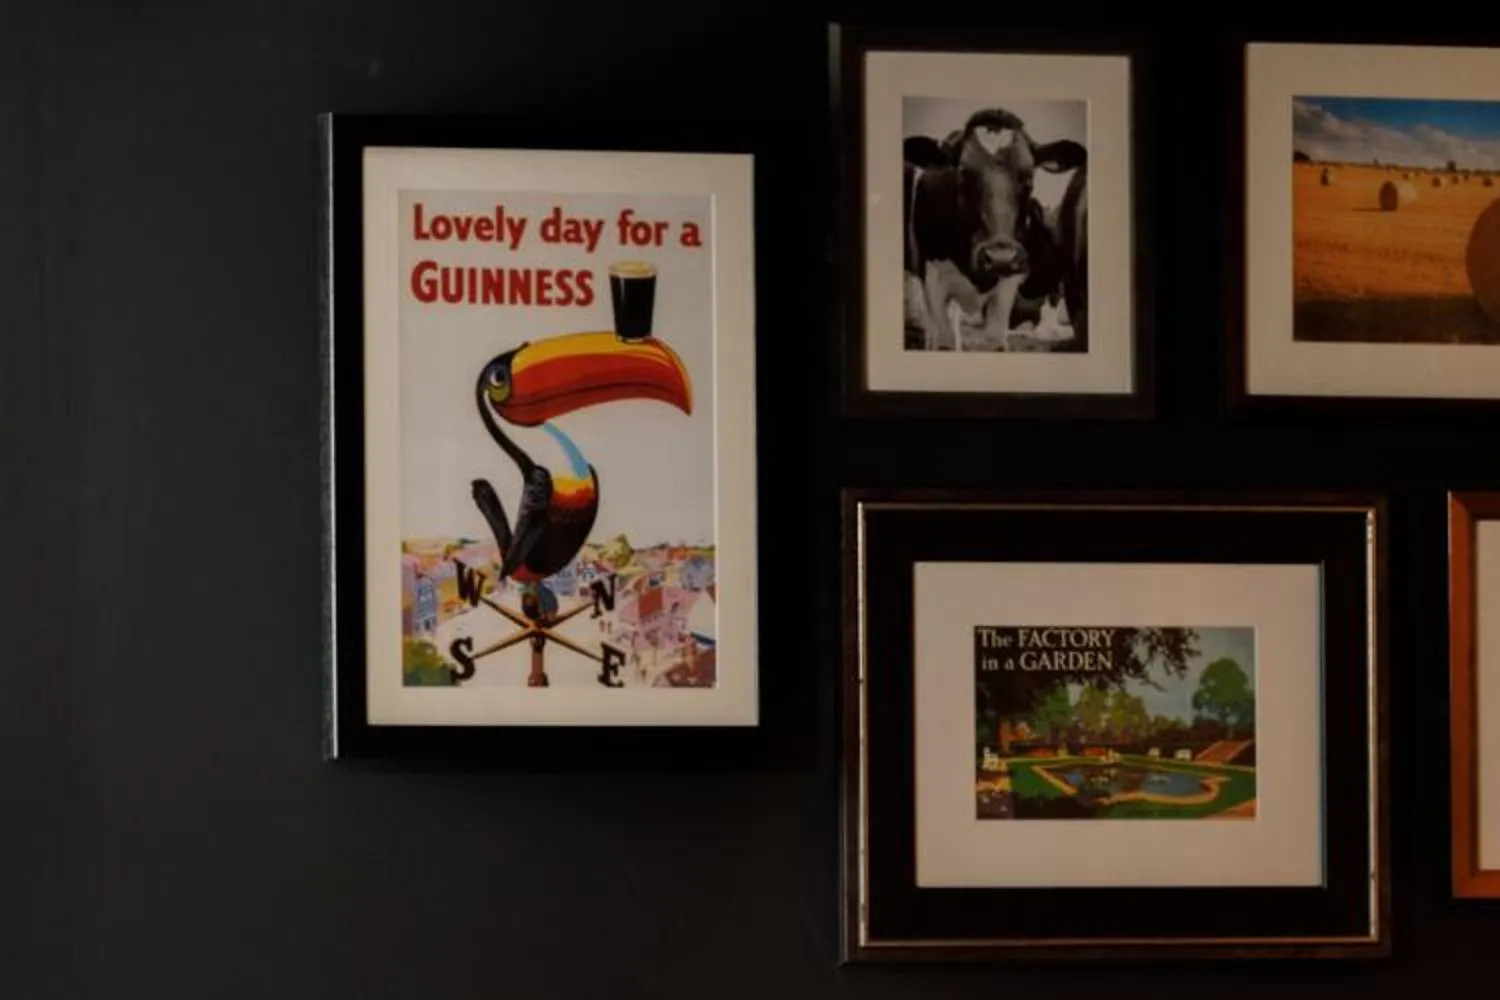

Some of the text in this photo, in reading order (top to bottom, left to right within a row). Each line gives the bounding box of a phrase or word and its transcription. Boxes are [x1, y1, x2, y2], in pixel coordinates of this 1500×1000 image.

[413, 204, 702, 252] Lovely day for a
[411, 260, 595, 306] GUINNESS
[453, 556, 486, 607] W
[590, 573, 617, 618] N
[450, 637, 475, 683] S
[977, 629, 1117, 648] The FACTORY
[981, 650, 1115, 672] in a GARDEN
[598, 642, 625, 687] E
